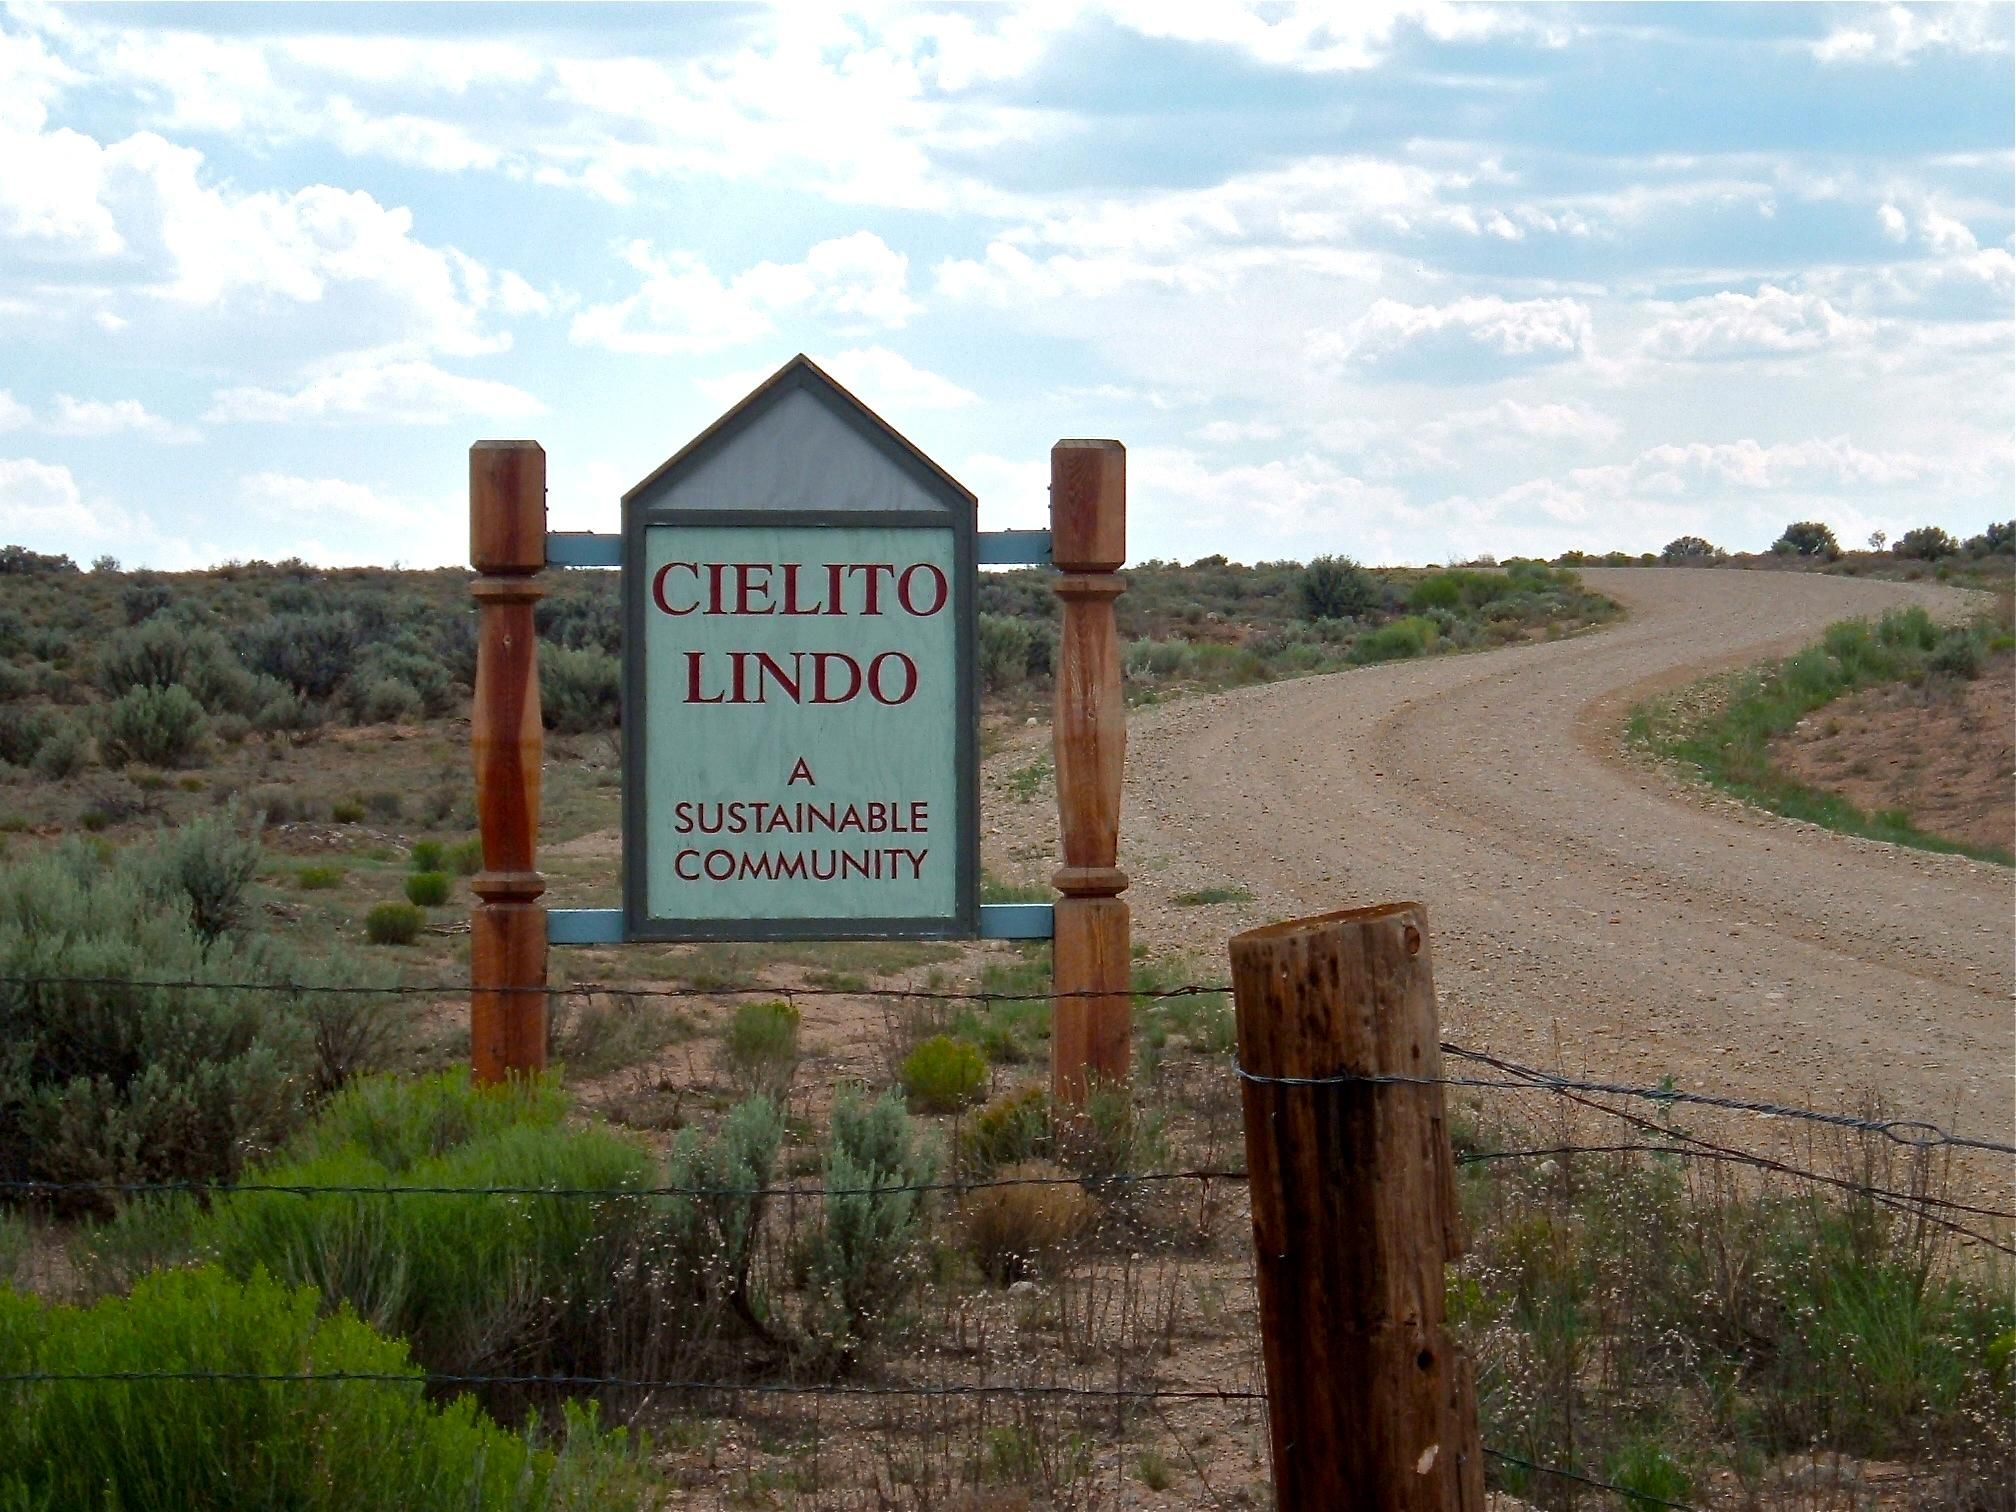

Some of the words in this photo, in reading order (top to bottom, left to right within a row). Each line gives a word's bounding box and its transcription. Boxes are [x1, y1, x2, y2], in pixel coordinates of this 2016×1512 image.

[652, 562, 948, 616] CIELITO
[683, 651, 918, 705] LINDO
[787, 757, 816, 786] A
[674, 802, 928, 833] SUSTAINABLE
[674, 849, 928, 880] COMMUNITY
